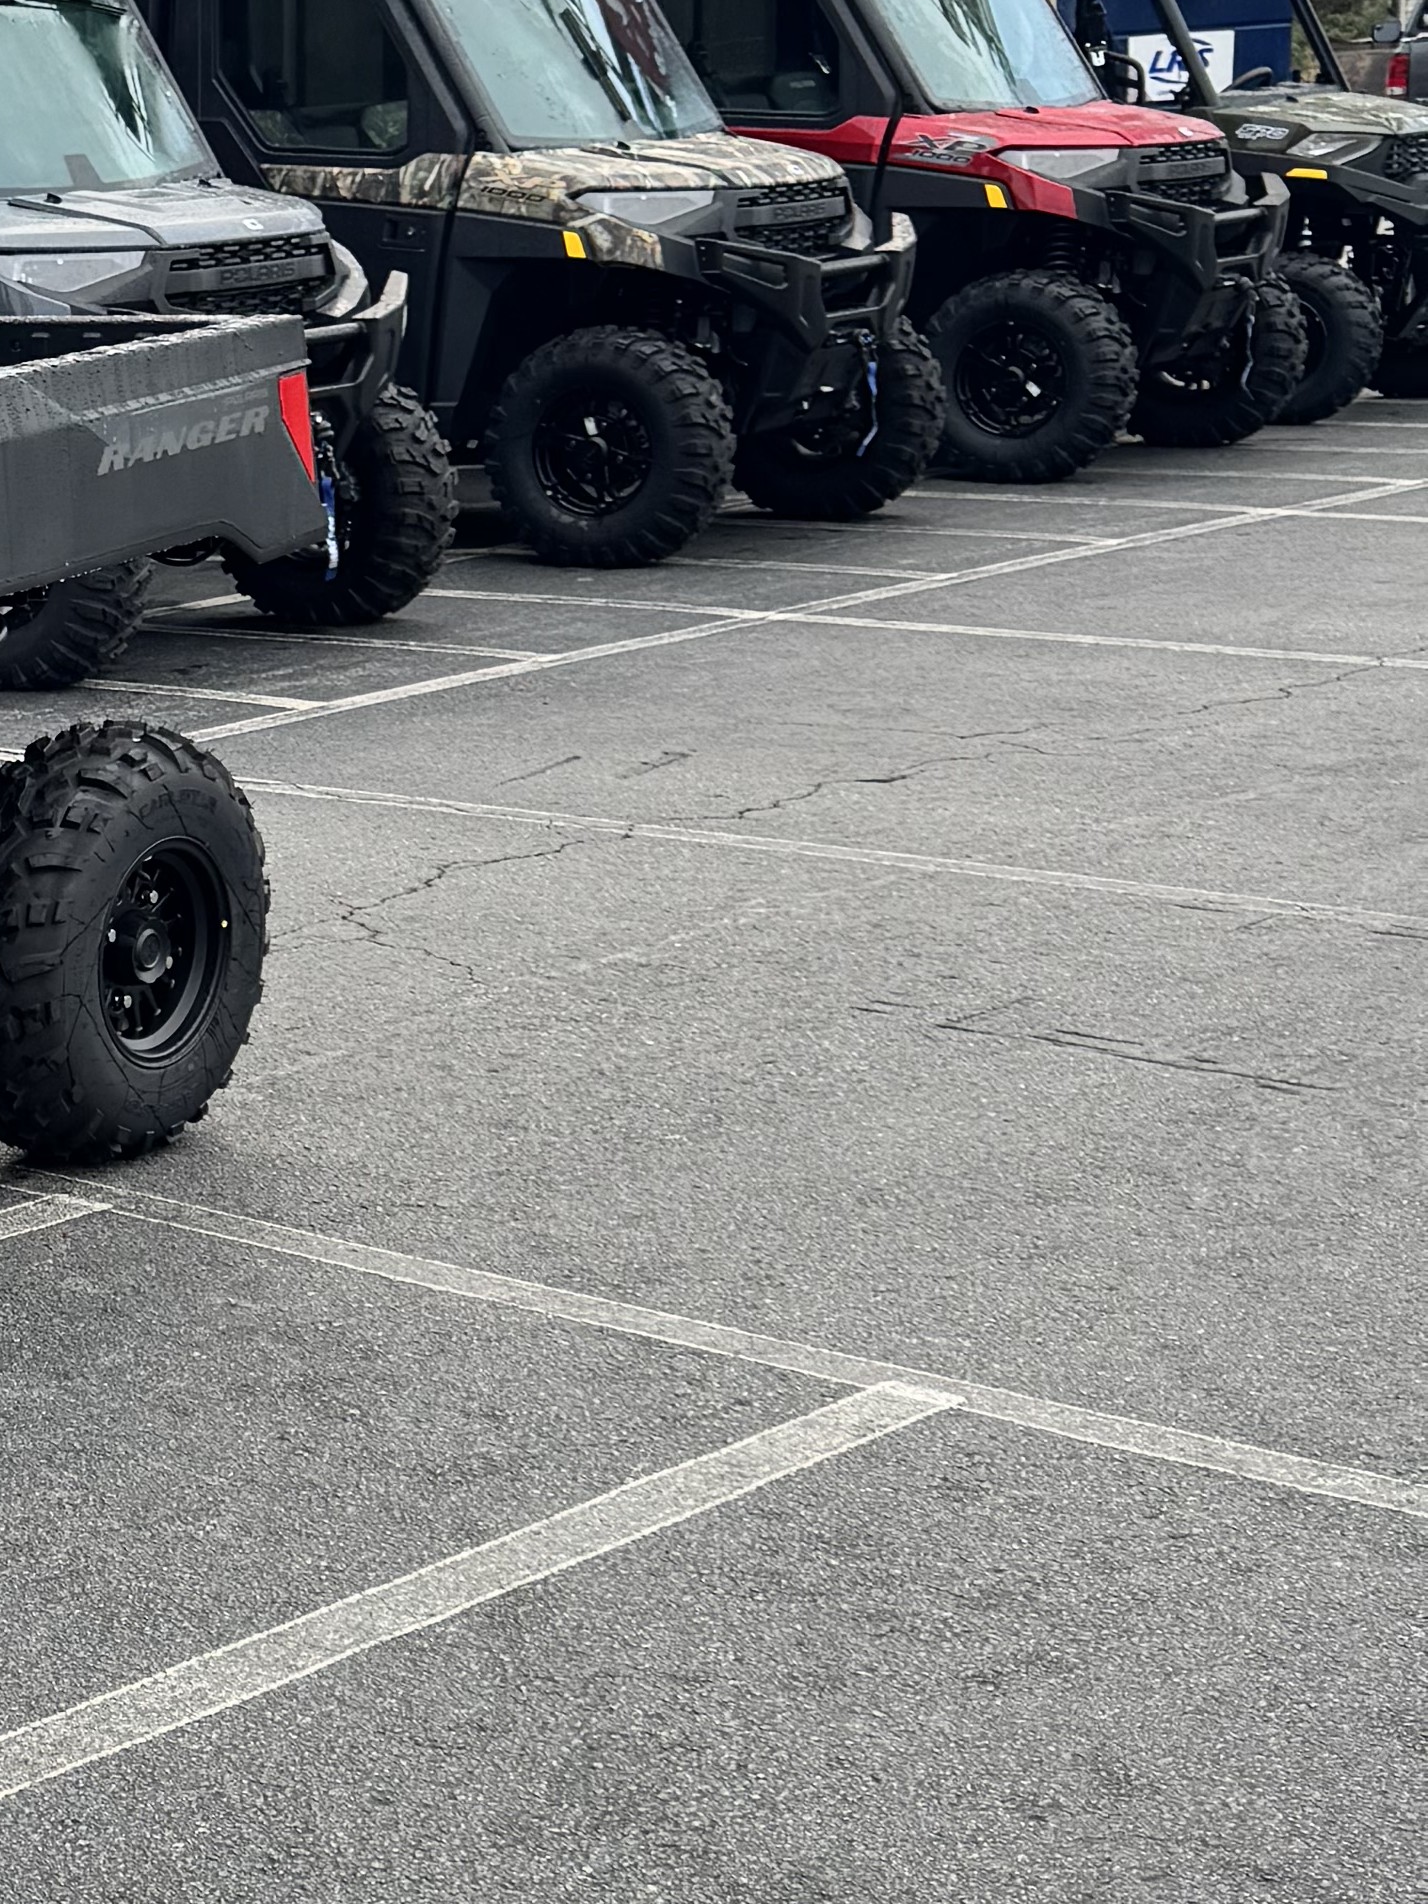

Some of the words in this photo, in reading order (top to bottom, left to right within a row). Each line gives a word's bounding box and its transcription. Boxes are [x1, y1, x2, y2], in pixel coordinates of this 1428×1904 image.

[911, 149, 971, 163] 1000
[480, 185, 546, 203] 1000
[221, 262, 296, 284] POLARIS
[96, 405, 270, 477] RANGER
